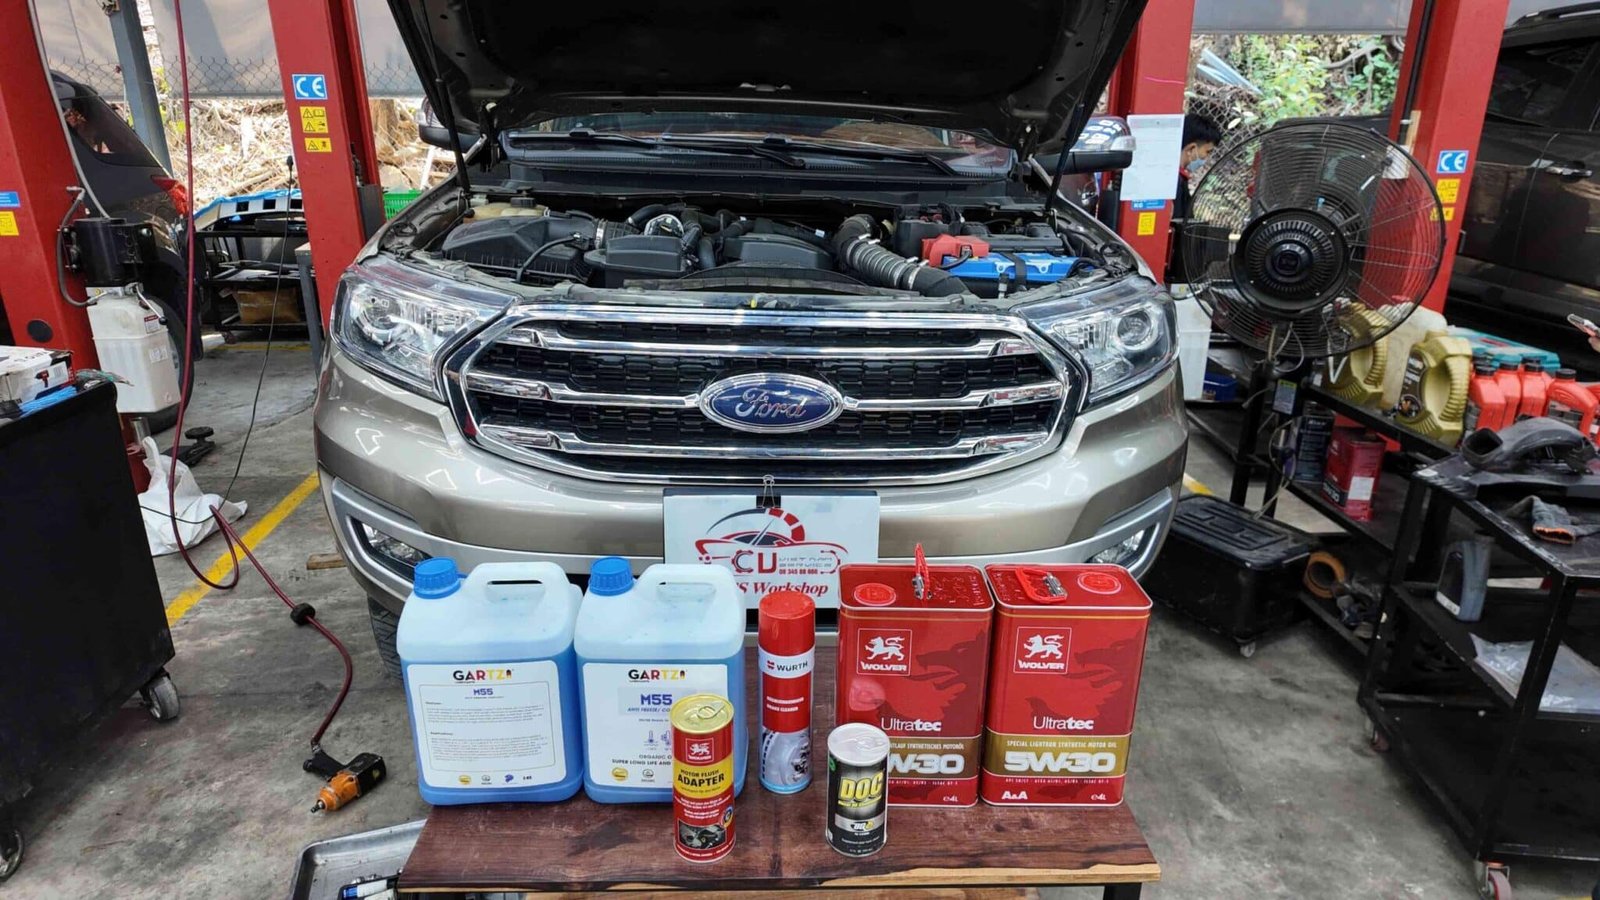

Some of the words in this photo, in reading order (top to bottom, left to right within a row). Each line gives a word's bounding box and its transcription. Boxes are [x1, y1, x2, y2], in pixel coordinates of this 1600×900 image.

[296, 76, 325, 97] CE
[1440, 152, 1466, 171] CE
[735, 387, 807, 418] Ford
[753, 581, 829, 597] Workshop
[860, 661, 907, 671] WOLVER
[1018, 659, 1065, 670] WOLVER
[453, 669, 506, 681] GARTZ
[628, 669, 680, 681] GARTZ
[640, 694, 673, 706] M55
[880, 716, 942, 731] Ultratec
[1033, 715, 1094, 730] Ultratec
[888, 753, 965, 774] W-30
[1004, 750, 1117, 773] 5W-30
[677, 773, 725, 788] ADAPTER
[840, 771, 884, 801] DOC
